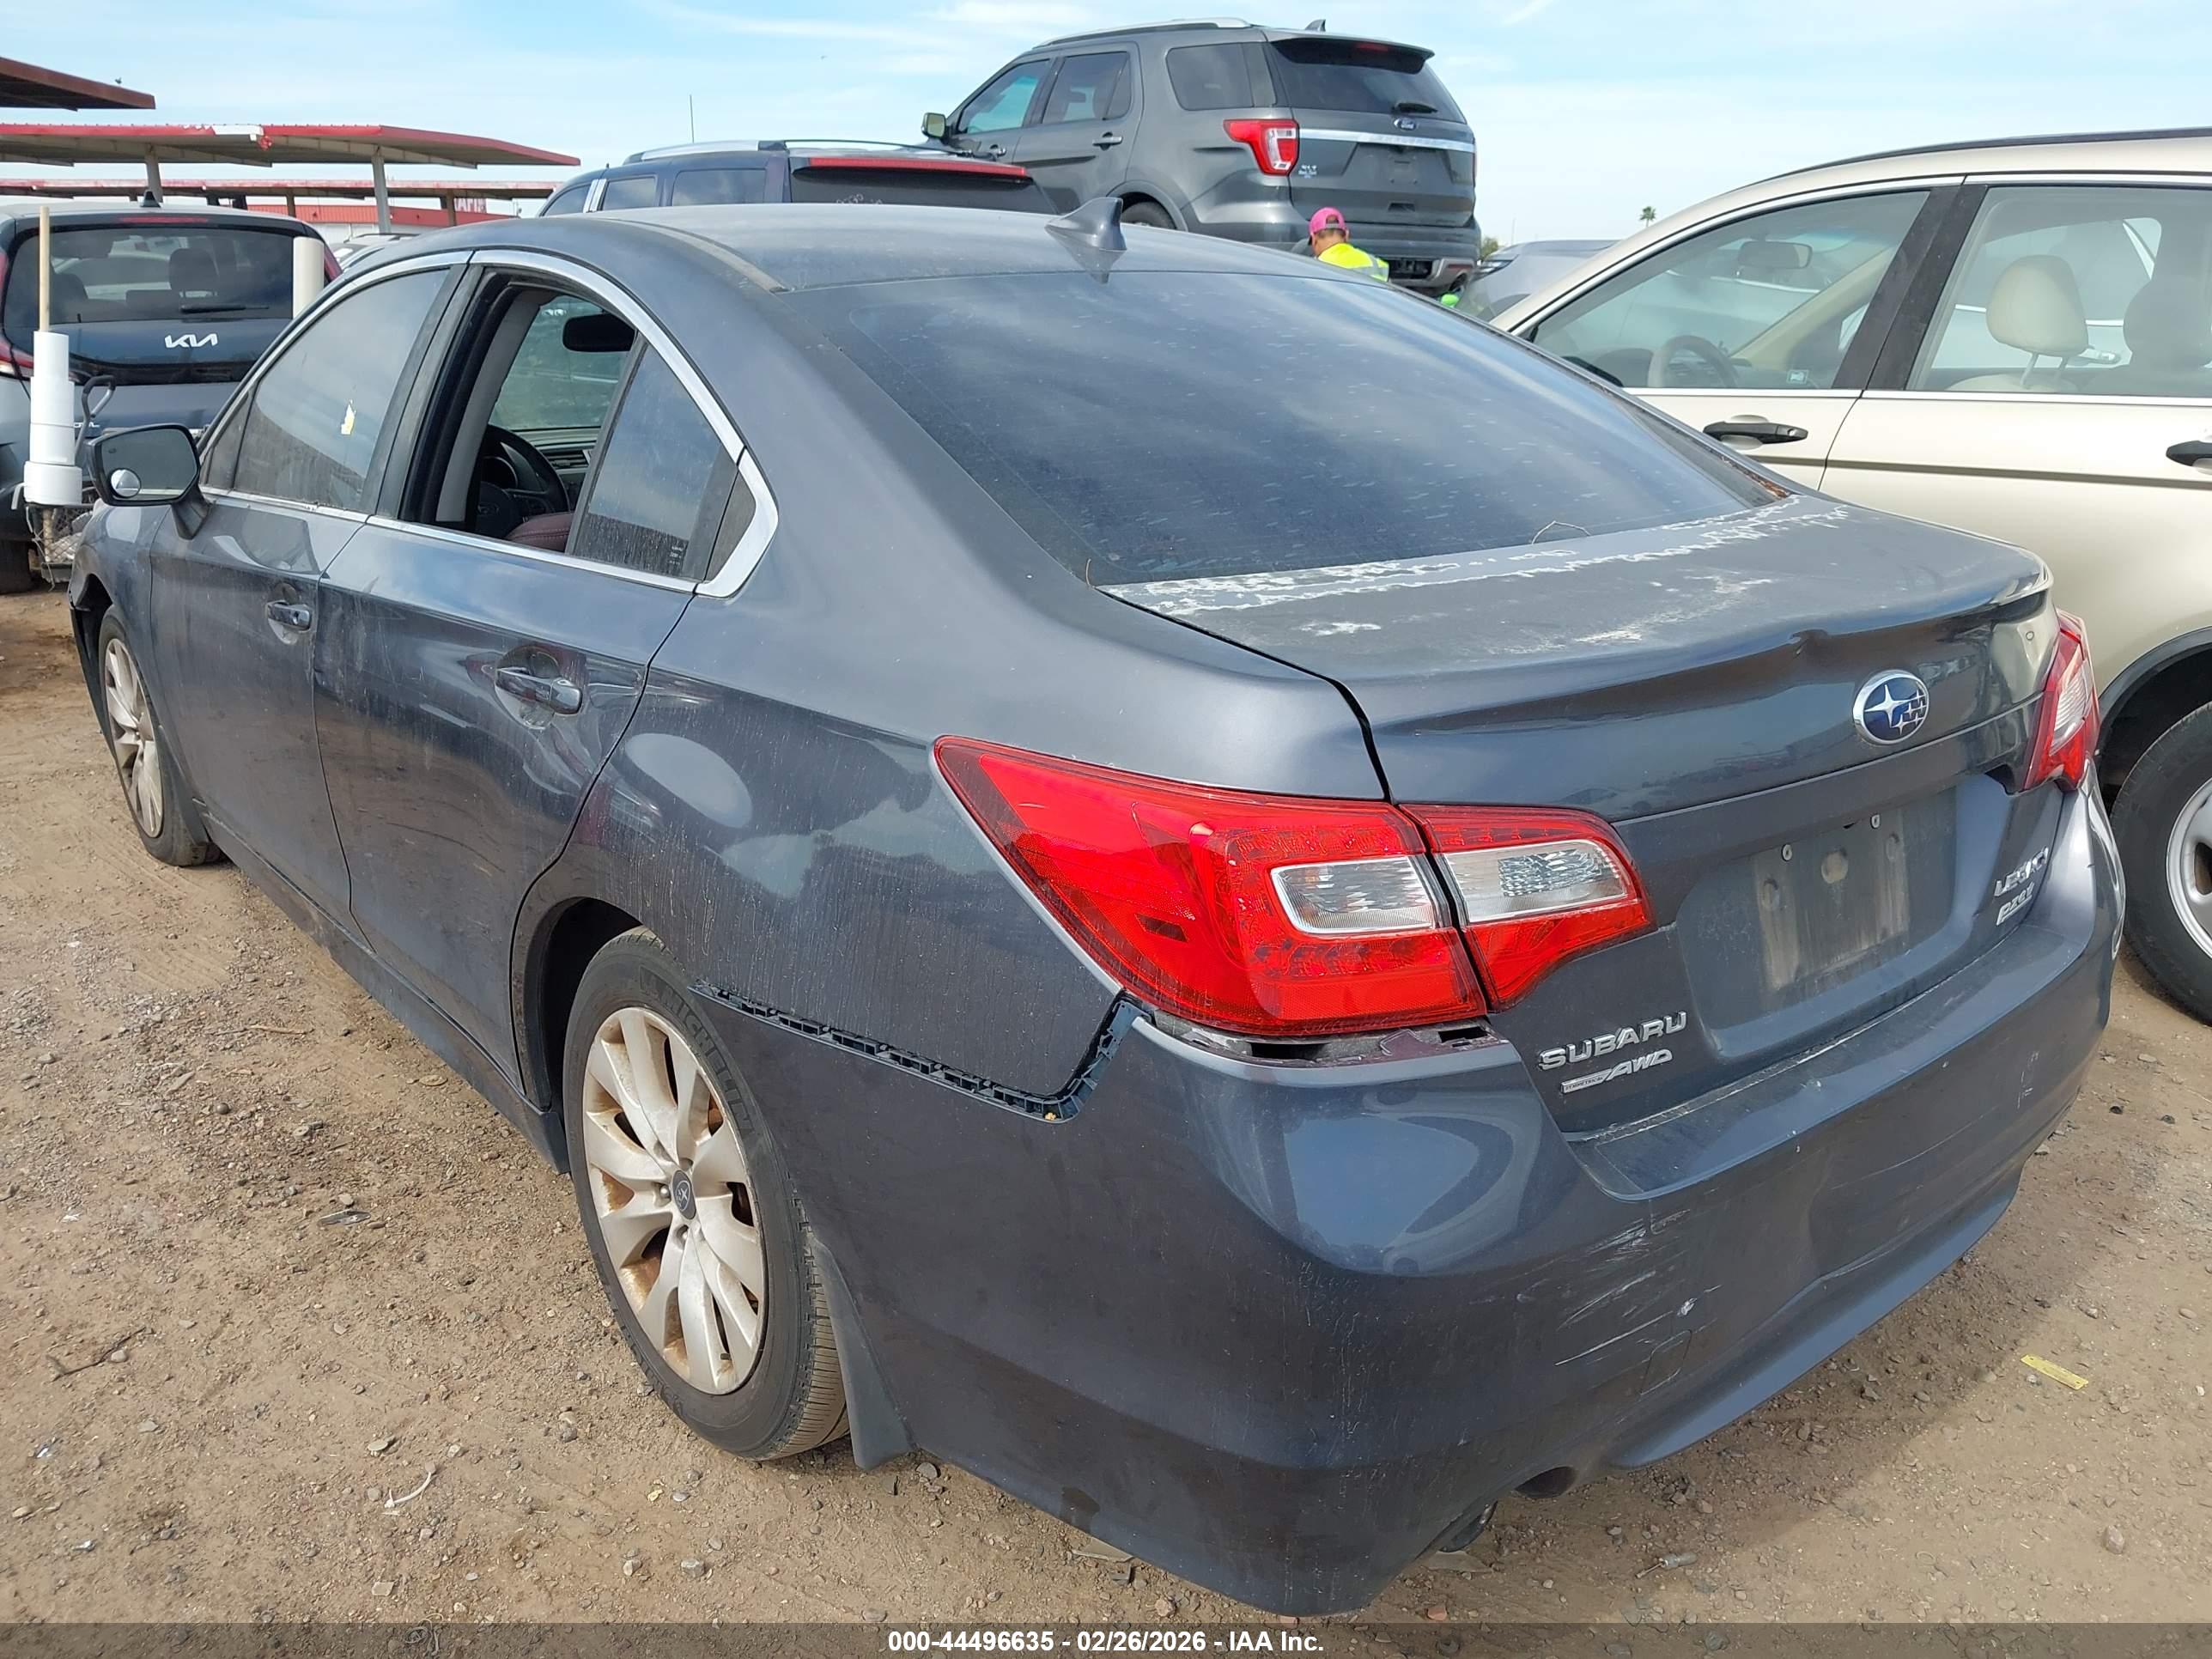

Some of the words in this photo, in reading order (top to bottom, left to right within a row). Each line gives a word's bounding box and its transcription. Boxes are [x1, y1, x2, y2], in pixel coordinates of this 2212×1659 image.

[165, 333, 218, 348] KIA
[1538, 1011, 1686, 1071] SUBARU
[1606, 1048, 1674, 1082] AWD
